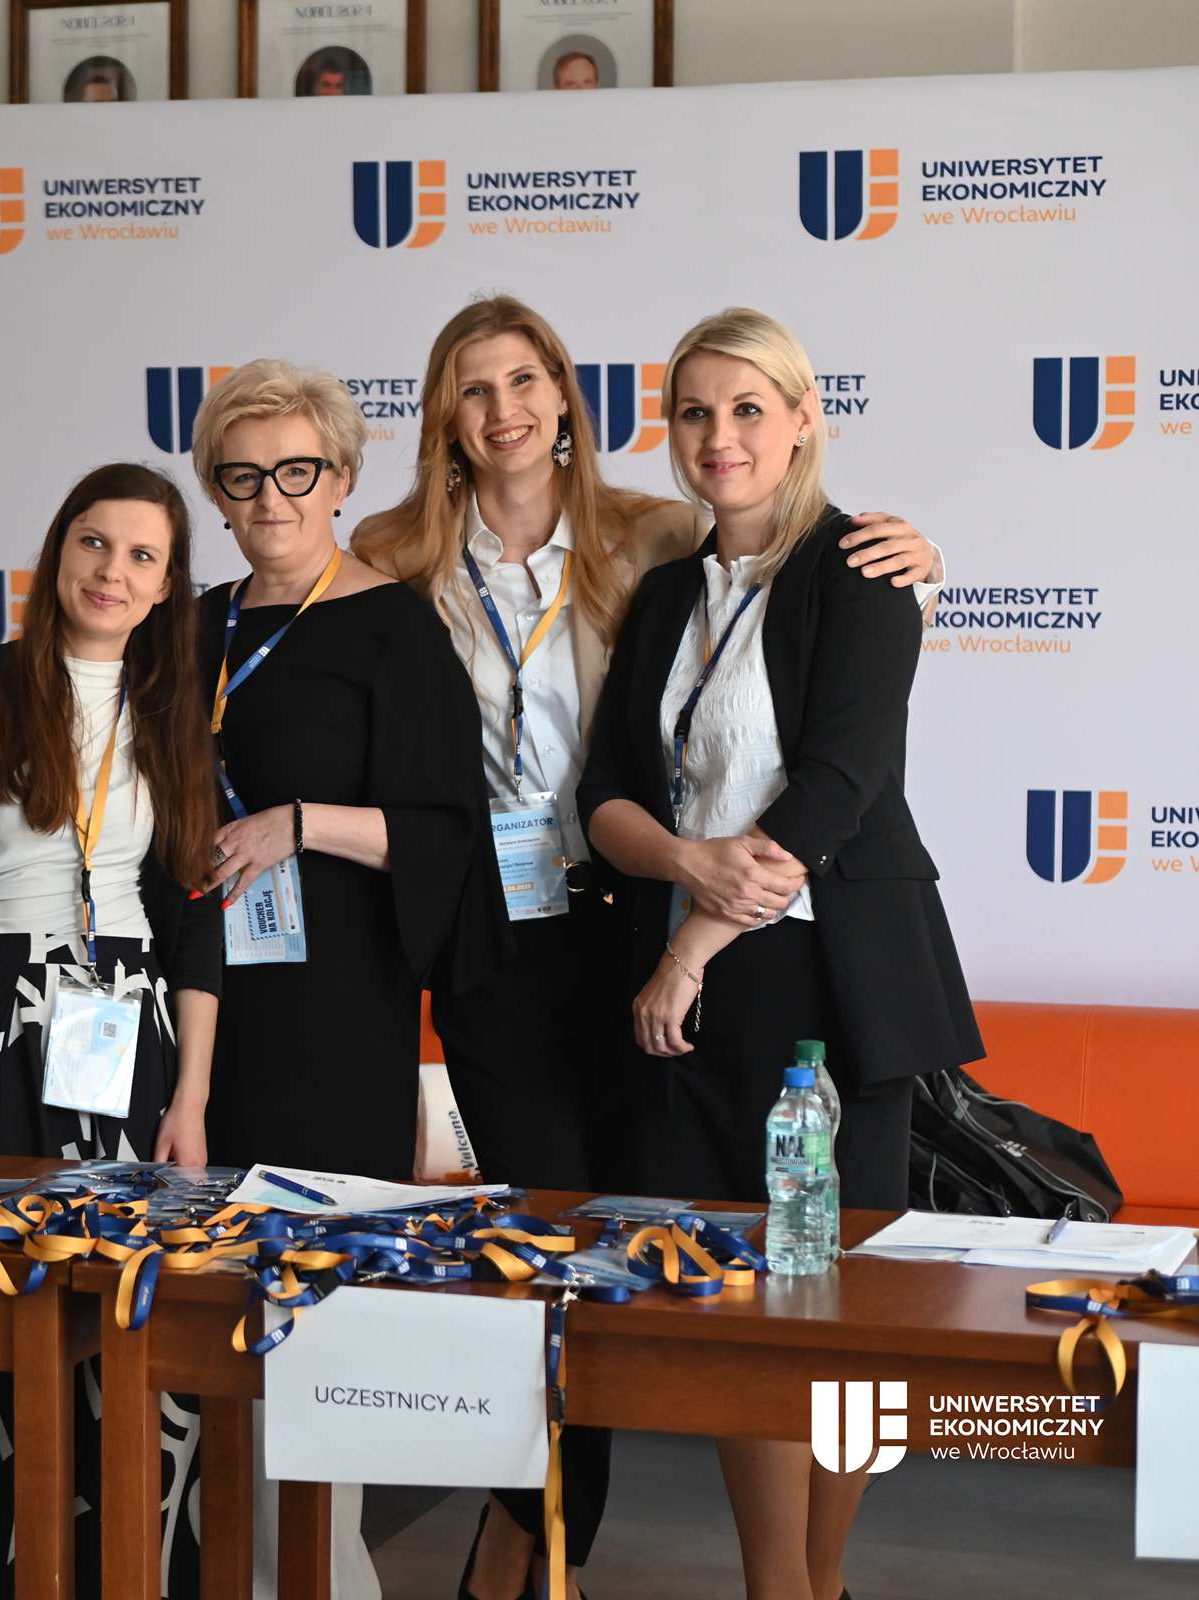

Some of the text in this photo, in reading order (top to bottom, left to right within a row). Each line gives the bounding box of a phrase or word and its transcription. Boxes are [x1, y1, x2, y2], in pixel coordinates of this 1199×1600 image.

[921, 155, 1104, 179] UNIWERSYTET
[43, 177, 201, 197] UNIWERSYTET
[466, 170, 637, 189] UNIWERSYTET
[921, 179, 1107, 202] EKONOMICZNY
[44, 199, 205, 219] EKONOMICZNY
[467, 192, 640, 212] EKONOMICZNY
[923, 203, 1077, 226] we Wrocławiu
[45, 222, 180, 241] we Wrocławiu
[468, 215, 612, 235] we Wrocławiu
[1160, 421, 1193, 435] we
[937, 587, 1099, 605] NIWERSYTET
[929, 611, 1102, 629] KONOMICZNY
[921, 634, 1073, 654] we Wrocławiu
[1152, 858, 1184, 873] we
[255, 901, 268, 935] VOUCHER
[267, 921, 278, 933] NA
[448, 1110, 475, 1169] Vulcano
[314, 1385, 491, 1415] UCZESTNICY A-K
